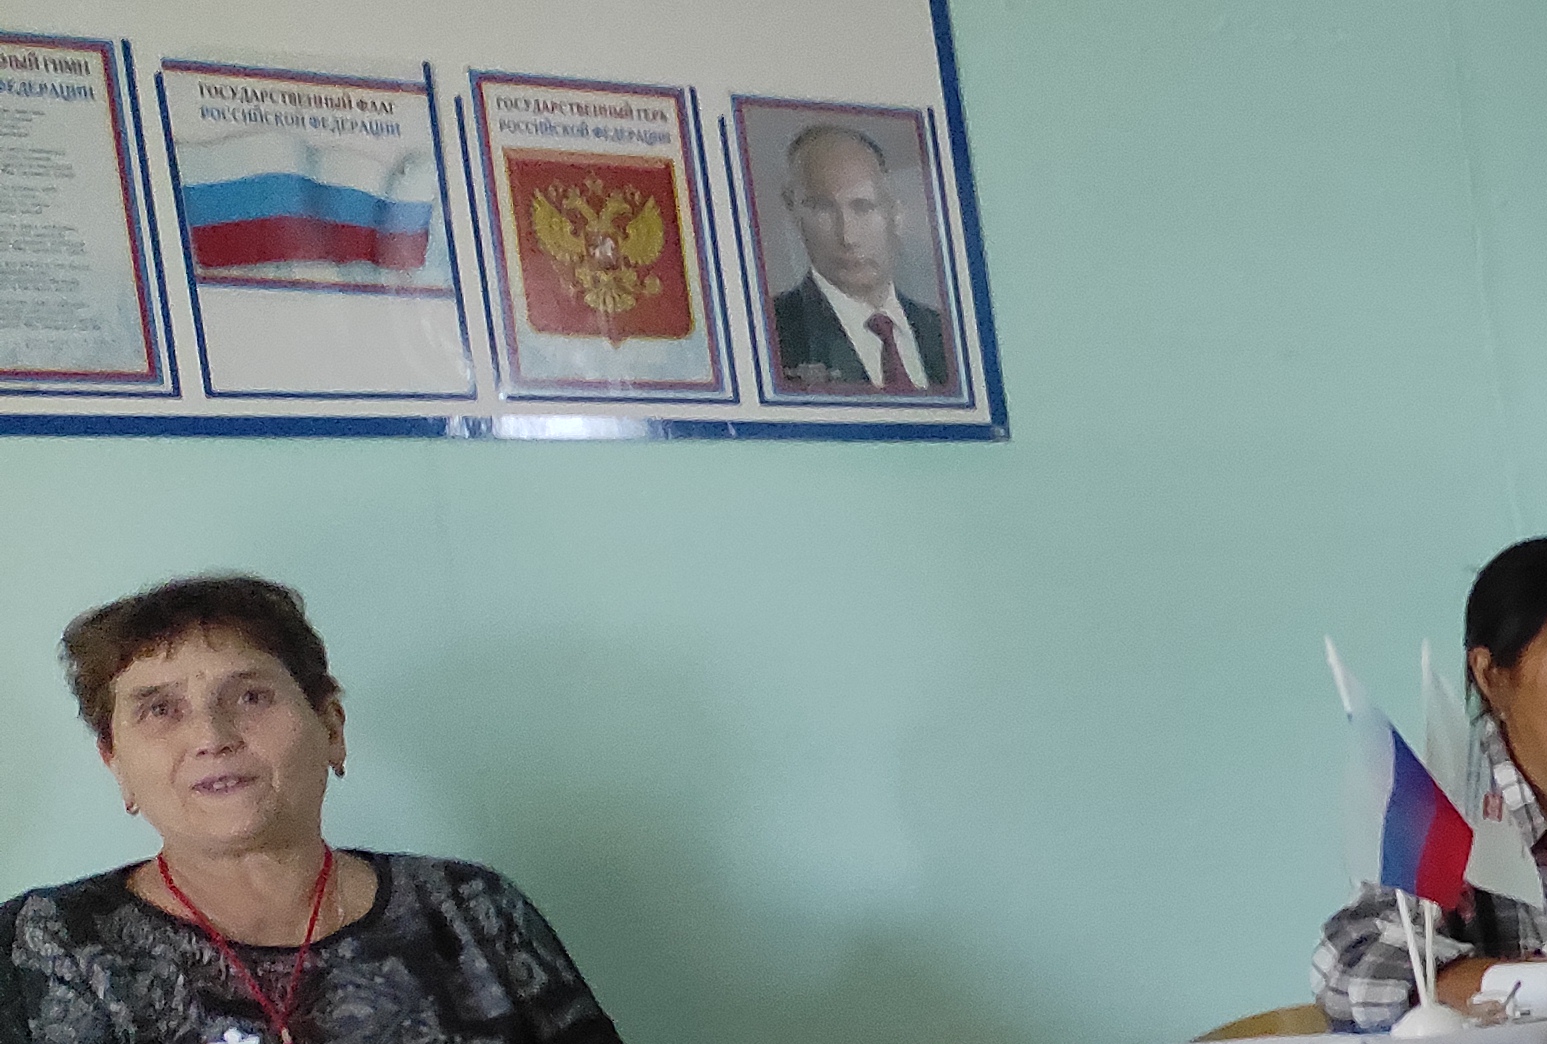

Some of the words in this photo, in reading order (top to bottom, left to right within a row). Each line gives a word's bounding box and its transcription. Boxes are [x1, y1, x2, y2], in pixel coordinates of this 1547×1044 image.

[199, 81, 353, 110] ГОСУДАРСТВЕННЫЙ
[356, 98, 395, 114] ФЛАГ
[200, 104, 306, 128] РОССИЙСКОЙ
[308, 115, 401, 137] ФЕДЕРАЦИИ
